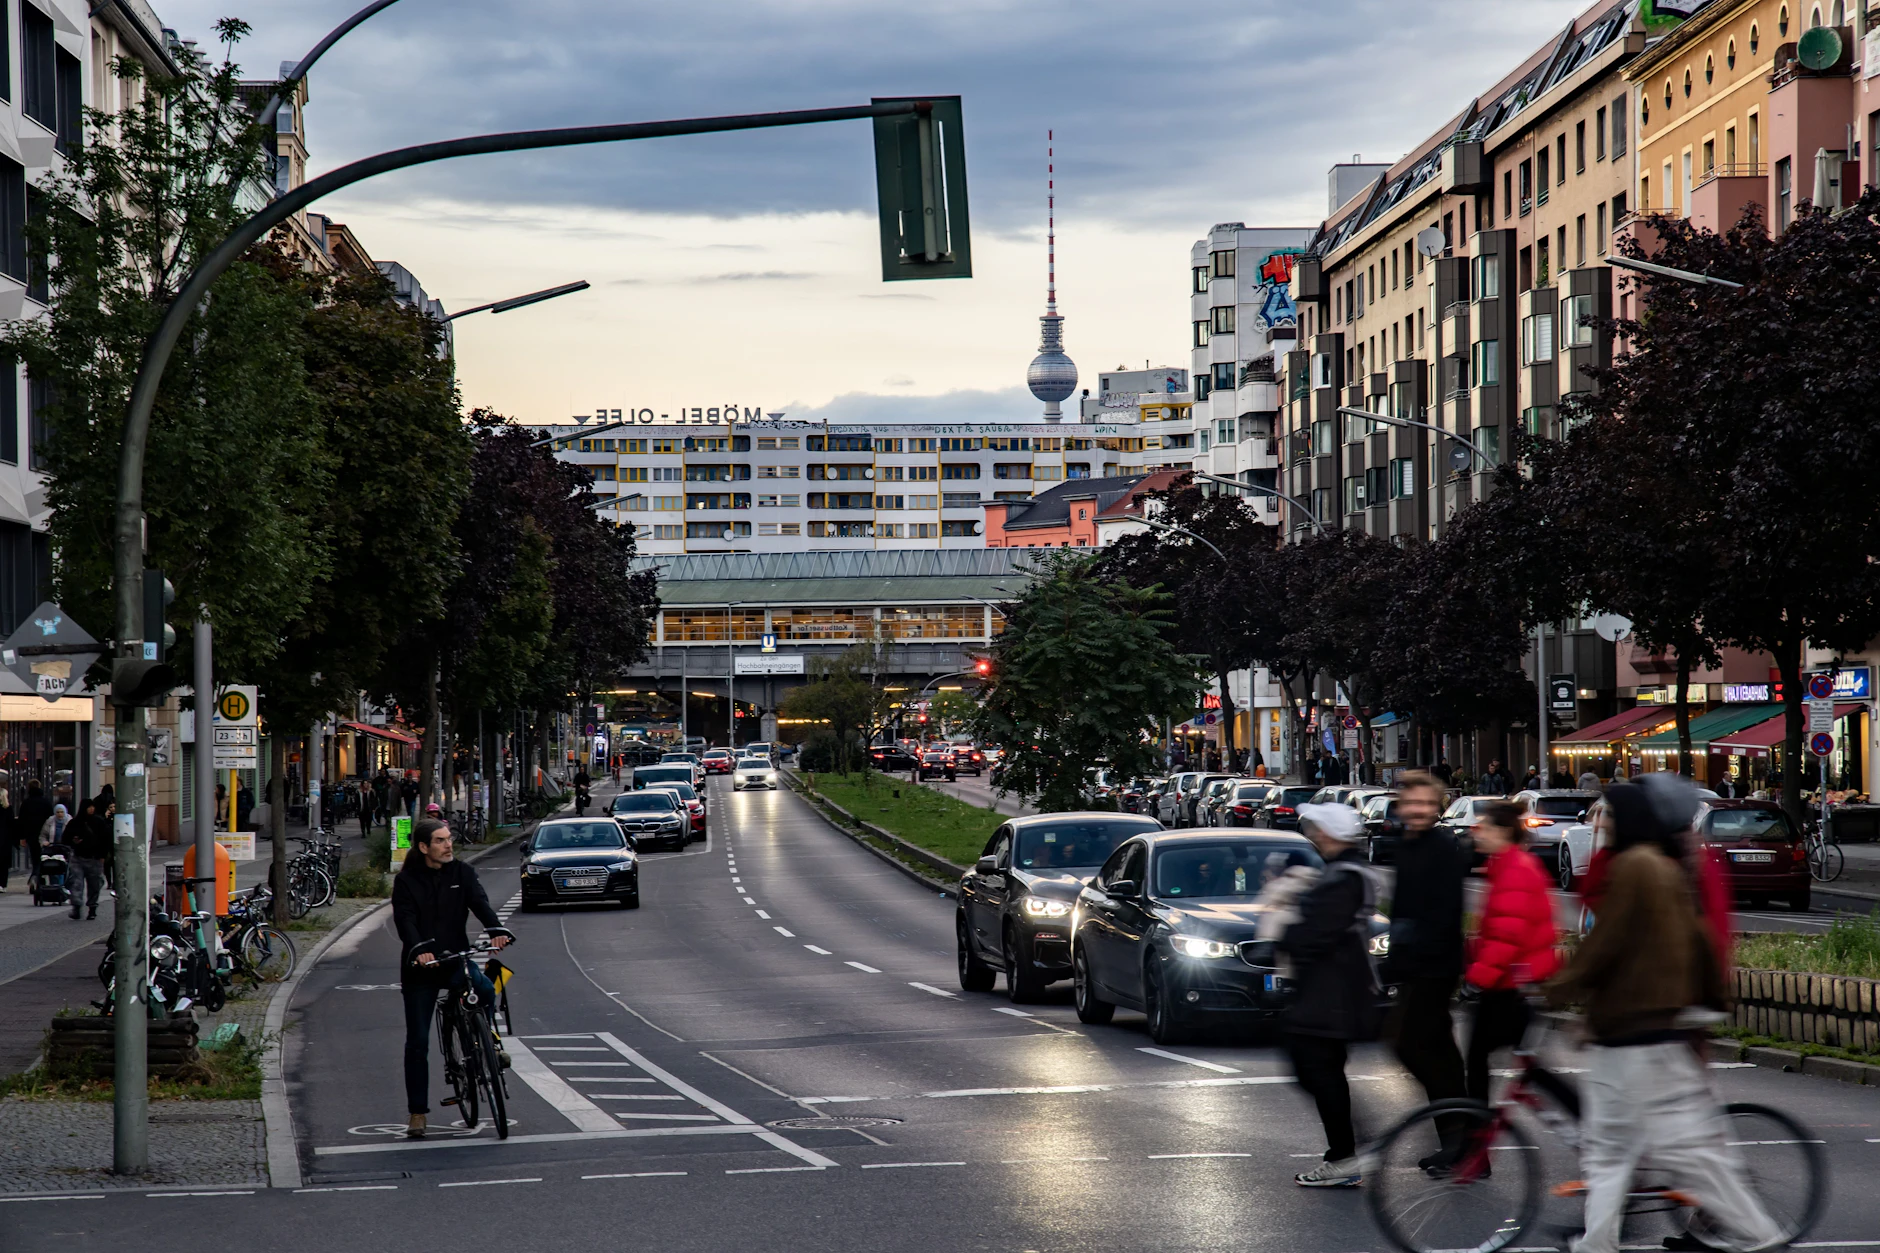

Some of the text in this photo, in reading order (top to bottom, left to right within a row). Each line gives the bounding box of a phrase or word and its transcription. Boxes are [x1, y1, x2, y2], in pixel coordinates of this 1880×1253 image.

[763, 635, 775, 647] U
[737, 662, 801, 670] Hochbahneingängen
[228, 697, 240, 715] H
[1197, 715, 1203, 723] P
[219, 732, 229, 740] 23
